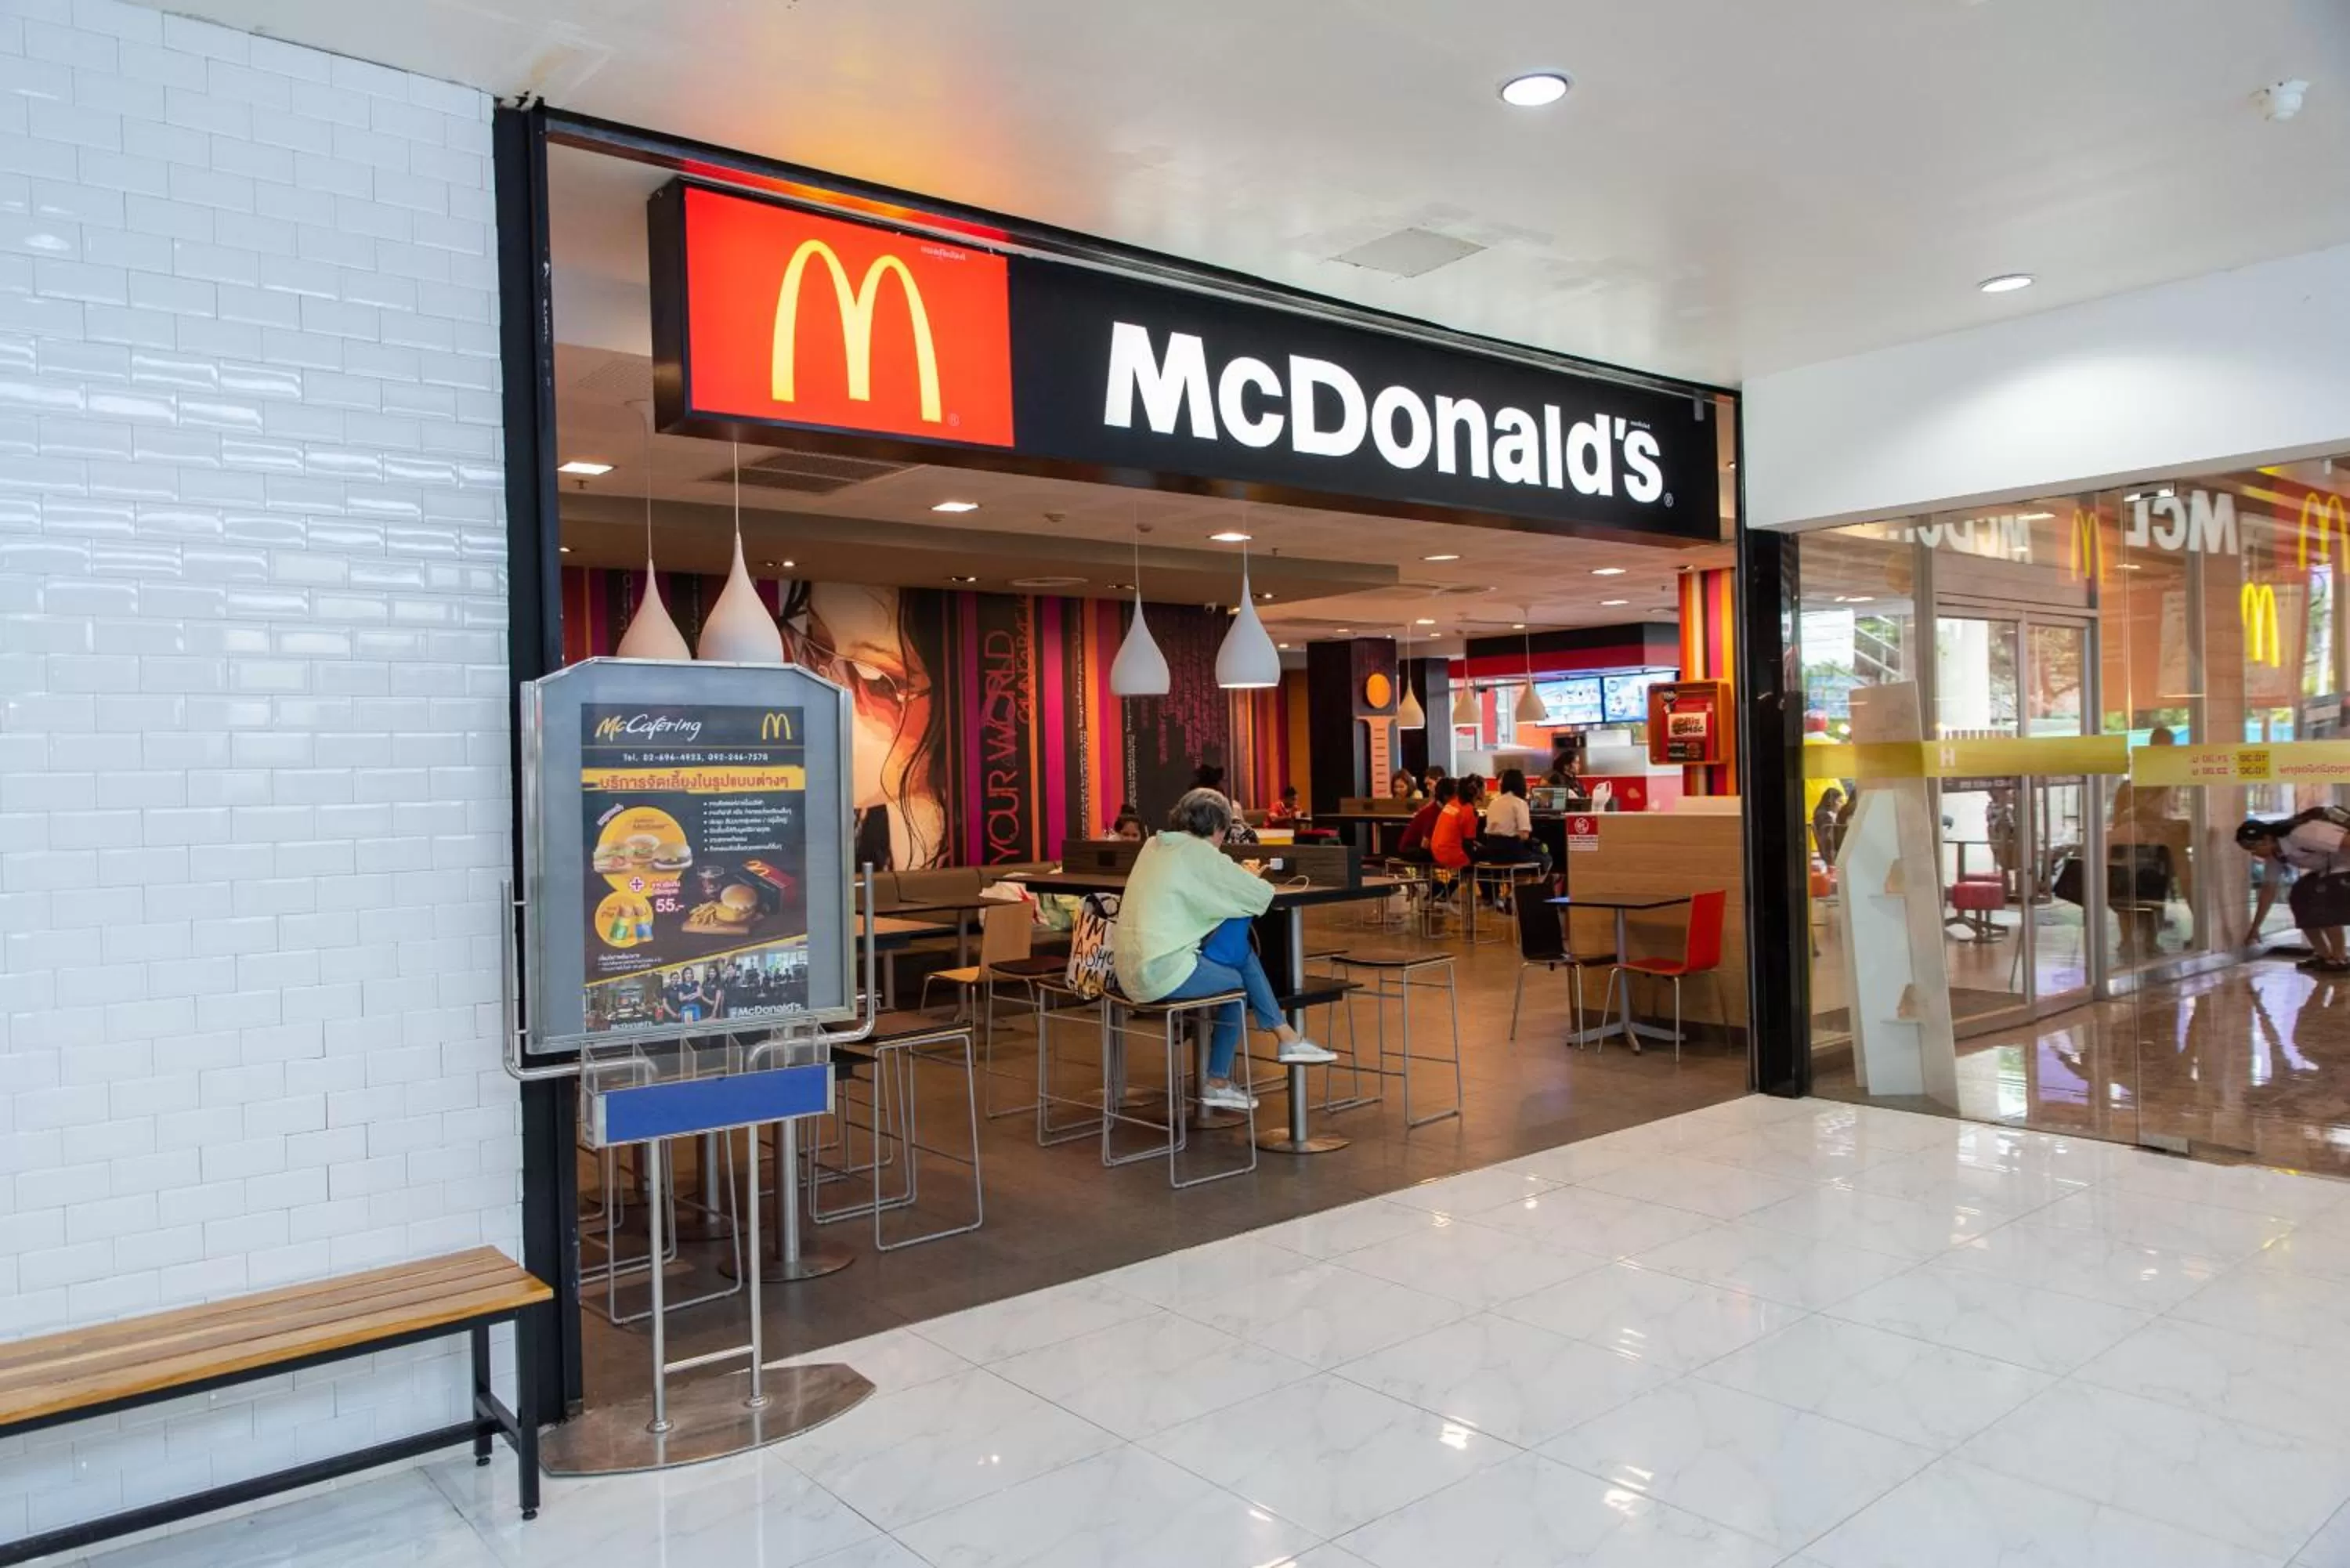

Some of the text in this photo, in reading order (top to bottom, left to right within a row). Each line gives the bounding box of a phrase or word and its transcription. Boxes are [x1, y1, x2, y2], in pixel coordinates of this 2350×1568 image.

[1104, 321, 1663, 504] McDonald's
[595, 714, 703, 742] McCatering
[623, 753, 638, 762] Tel.
[982, 630, 1020, 865] YOUR WORLD
